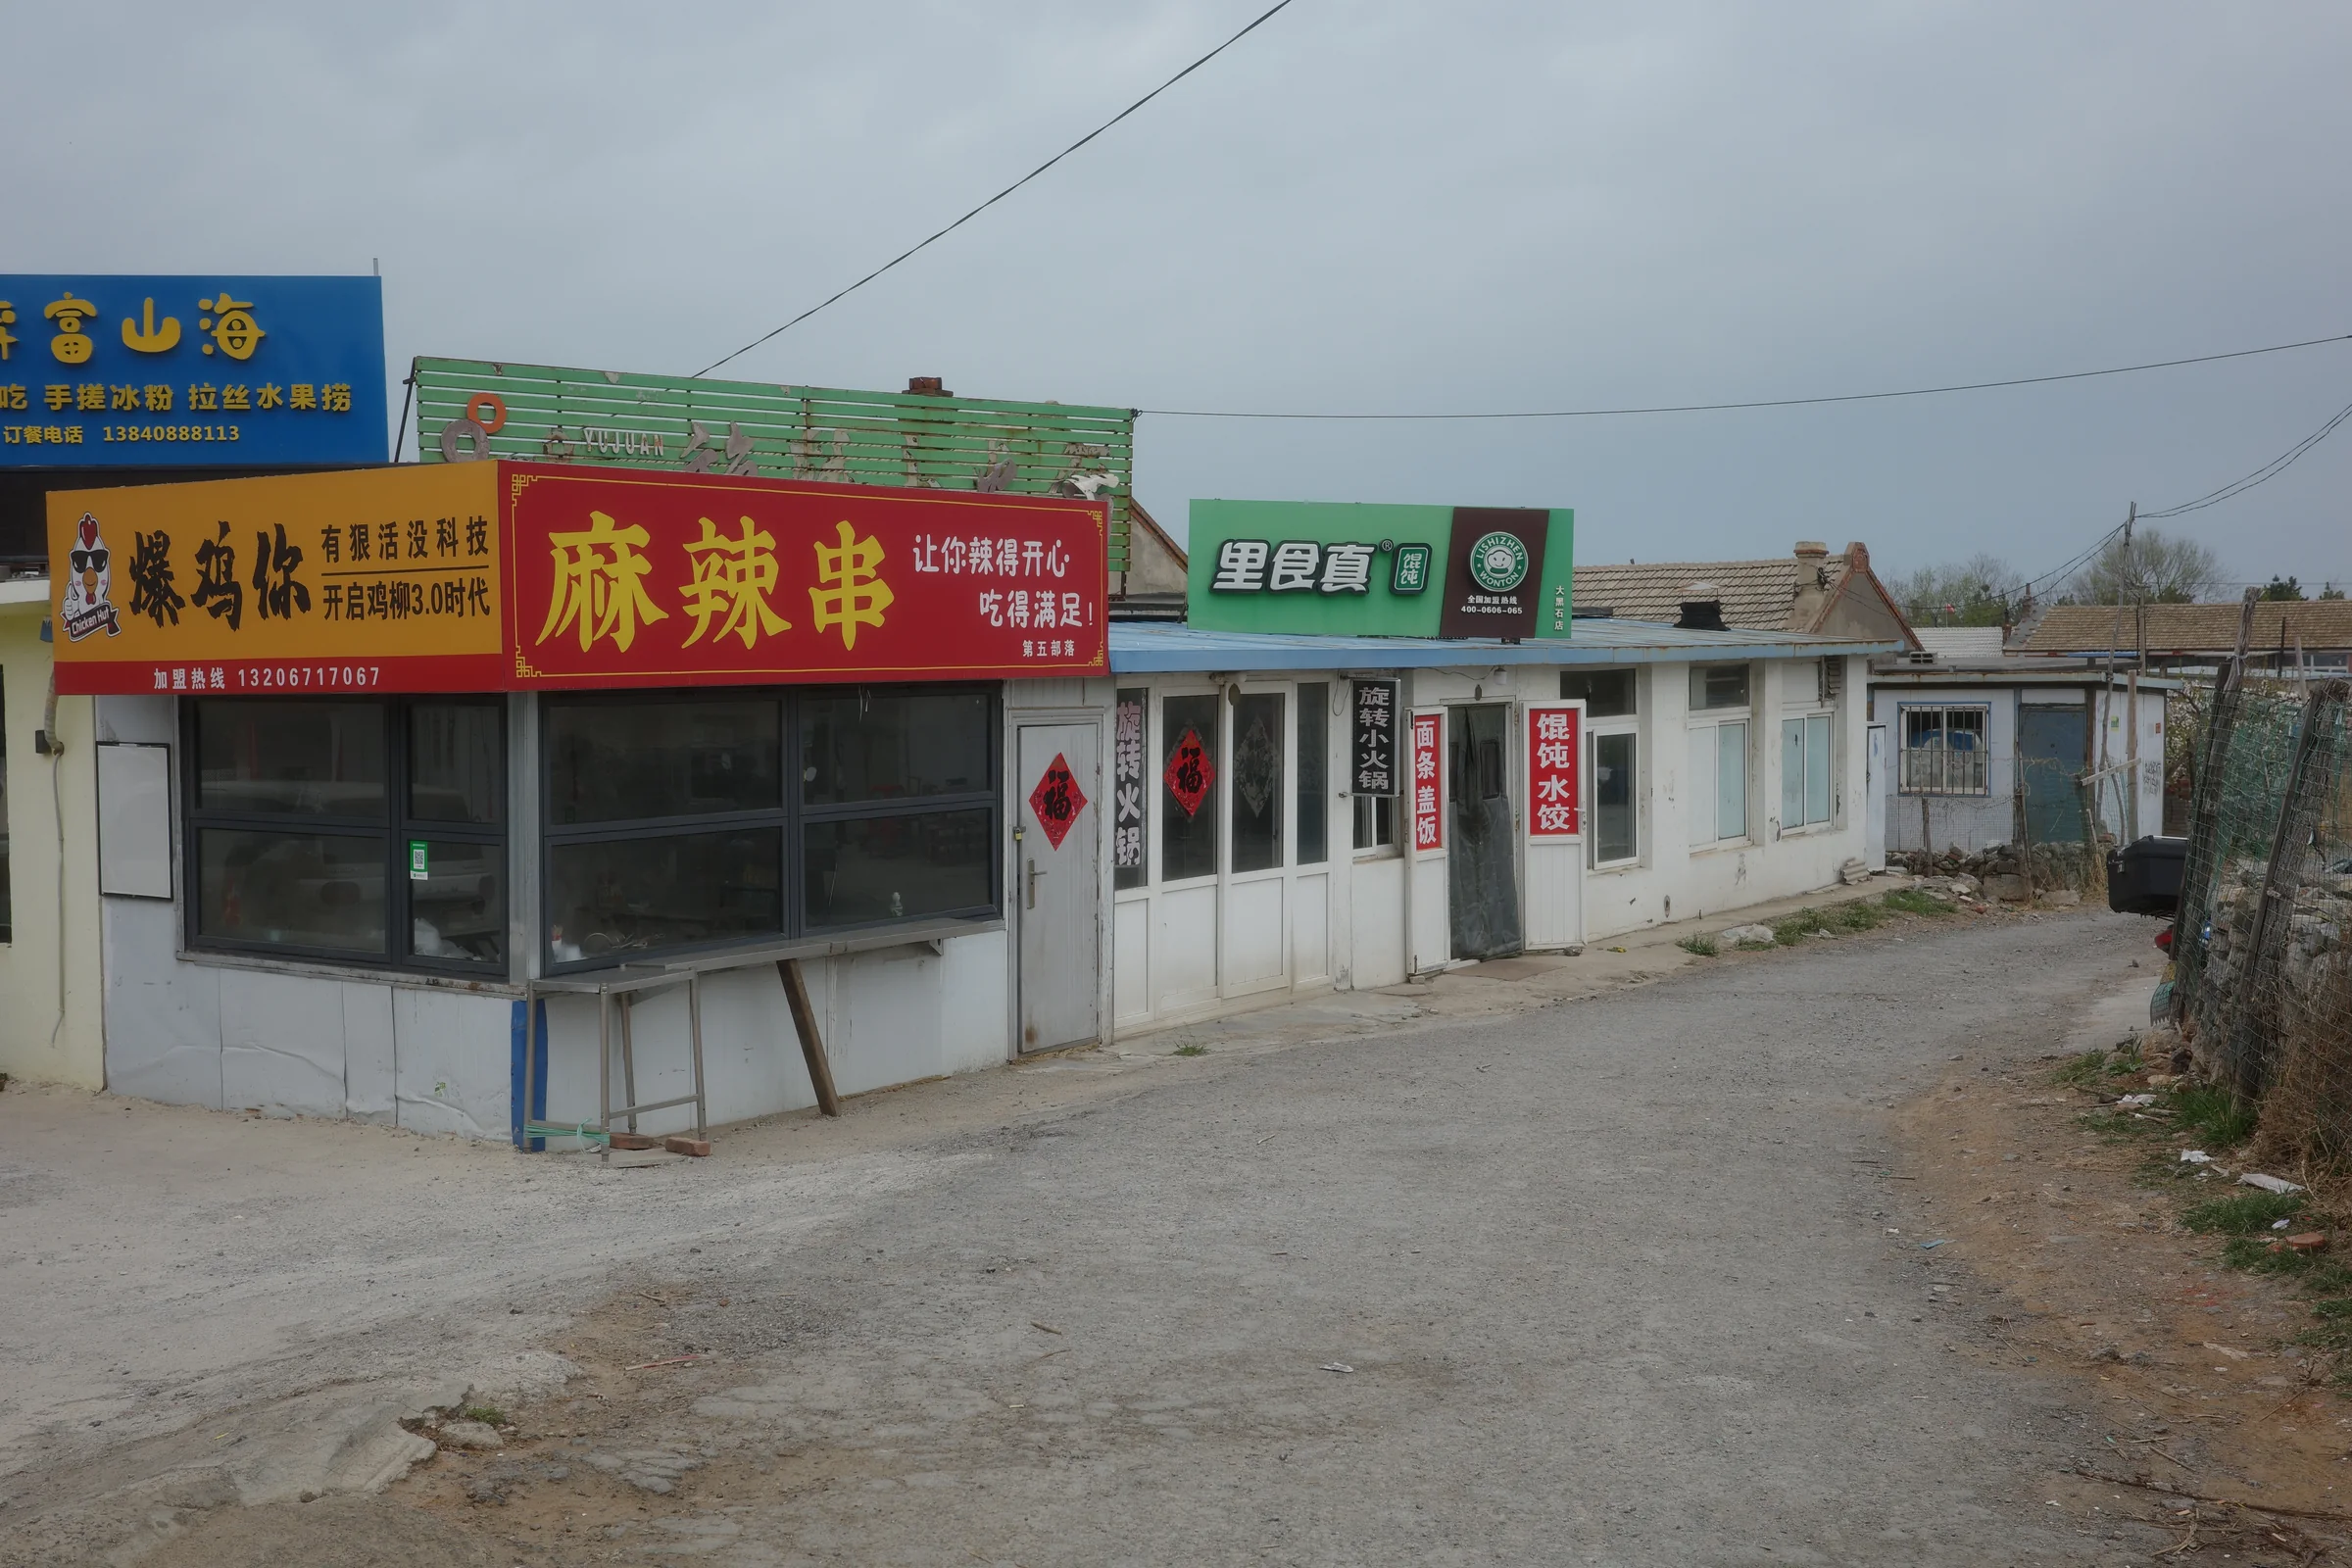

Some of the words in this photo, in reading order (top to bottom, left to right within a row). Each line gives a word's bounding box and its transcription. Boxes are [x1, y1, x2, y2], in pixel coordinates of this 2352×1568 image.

[43, 383, 173, 412] 手搓冰粉
[188, 382, 352, 412] 拉丝水果捞
[4, 425, 83, 444] 订餐电话
[103, 425, 240, 442] 13840888113
[583, 428, 664, 457] YUJUAN
[321, 515, 489, 563] 有狠活没科技
[913, 534, 1070, 577] 让你辣得开心
[1476, 537, 1524, 561] LISHIZHEN
[128, 520, 312, 631] 爆鸡你
[535, 511, 895, 653] 麻辣串
[1212, 542, 1375, 593] 里食真
[1400, 553, 1422, 585] 馄饨
[1479, 570, 1519, 587] WONTON
[323, 576, 490, 620] 开启鸡柳3.0时代
[980, 589, 1093, 628] 吃得满足!
[1461, 606, 1522, 614] 400-0606-065
[1467, 595, 1517, 605] 全国加盟热线
[1554, 585, 1564, 630] 大黑石店
[72, 615, 97, 634] Chicken
[97, 607, 109, 622] Hut
[1022, 640, 1074, 657] 第五部落
[154, 667, 225, 690] 加盟热线
[238, 666, 379, 687] 13206717067
[1359, 687, 1390, 790] 旋转小火锅
[1116, 701, 1141, 866] 旋转火锅
[1177, 747, 1203, 794] 福
[1043, 769, 1071, 821] 福
